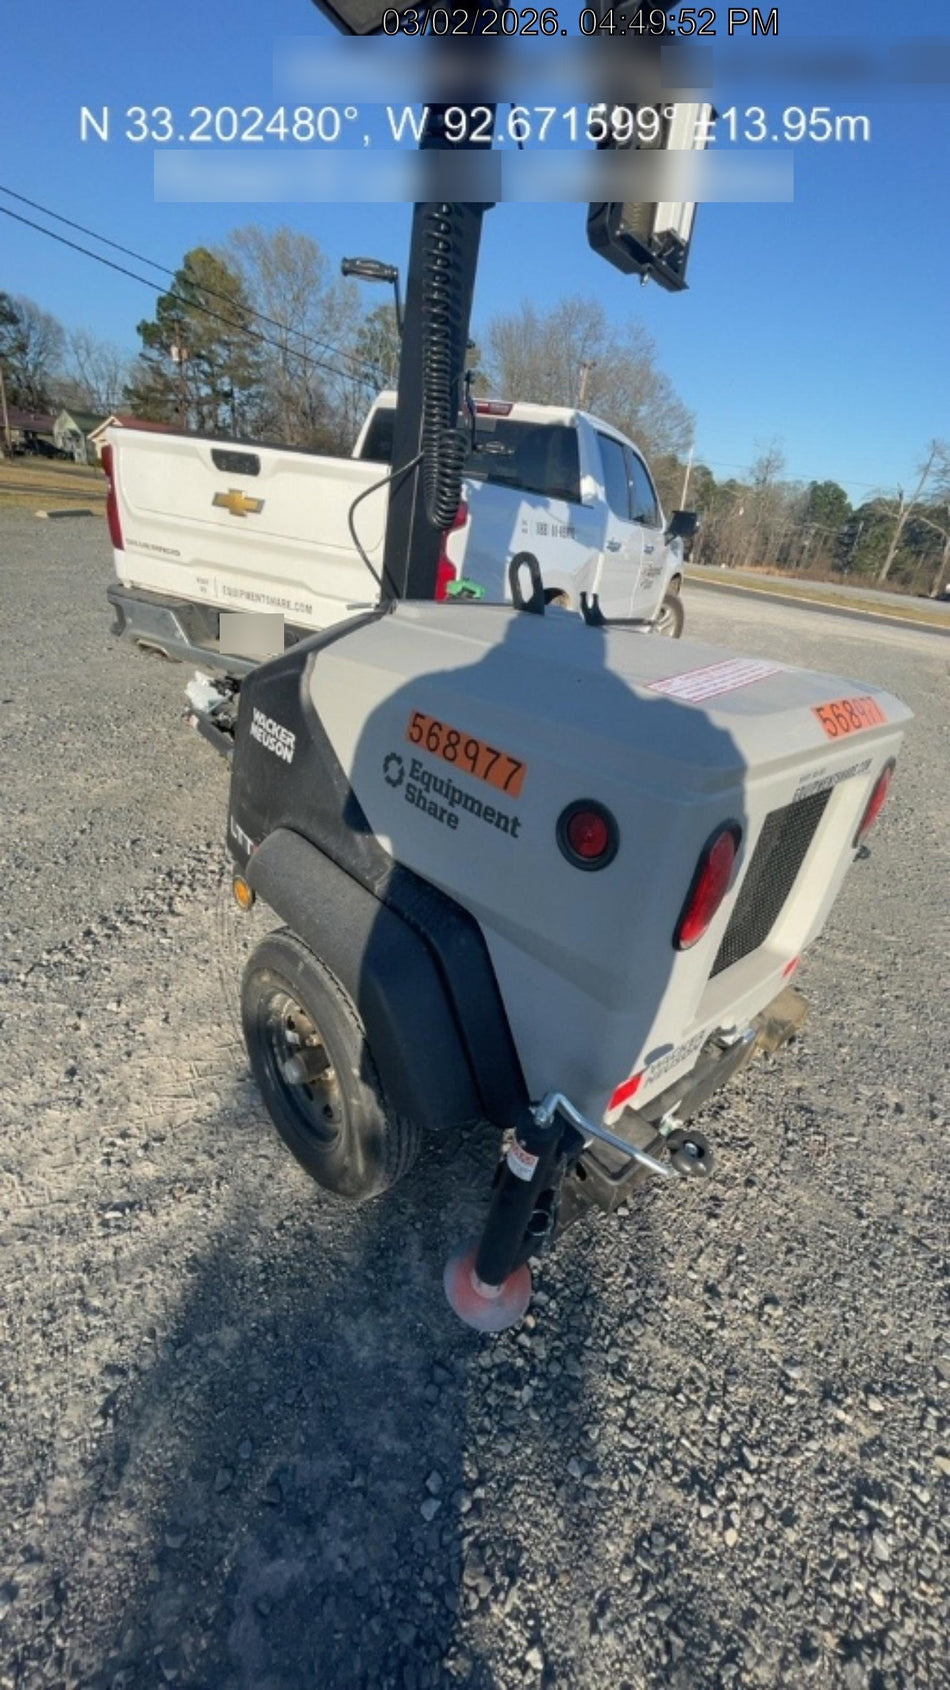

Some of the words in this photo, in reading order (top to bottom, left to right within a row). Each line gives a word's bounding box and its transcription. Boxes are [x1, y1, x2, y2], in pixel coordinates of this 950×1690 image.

[250, 721, 294, 764] NEUSON
[252, 706, 296, 748] WACKER
[408, 711, 523, 790] 568977
[404, 786, 459, 831] Share
[409, 758, 522, 838] Equipment
